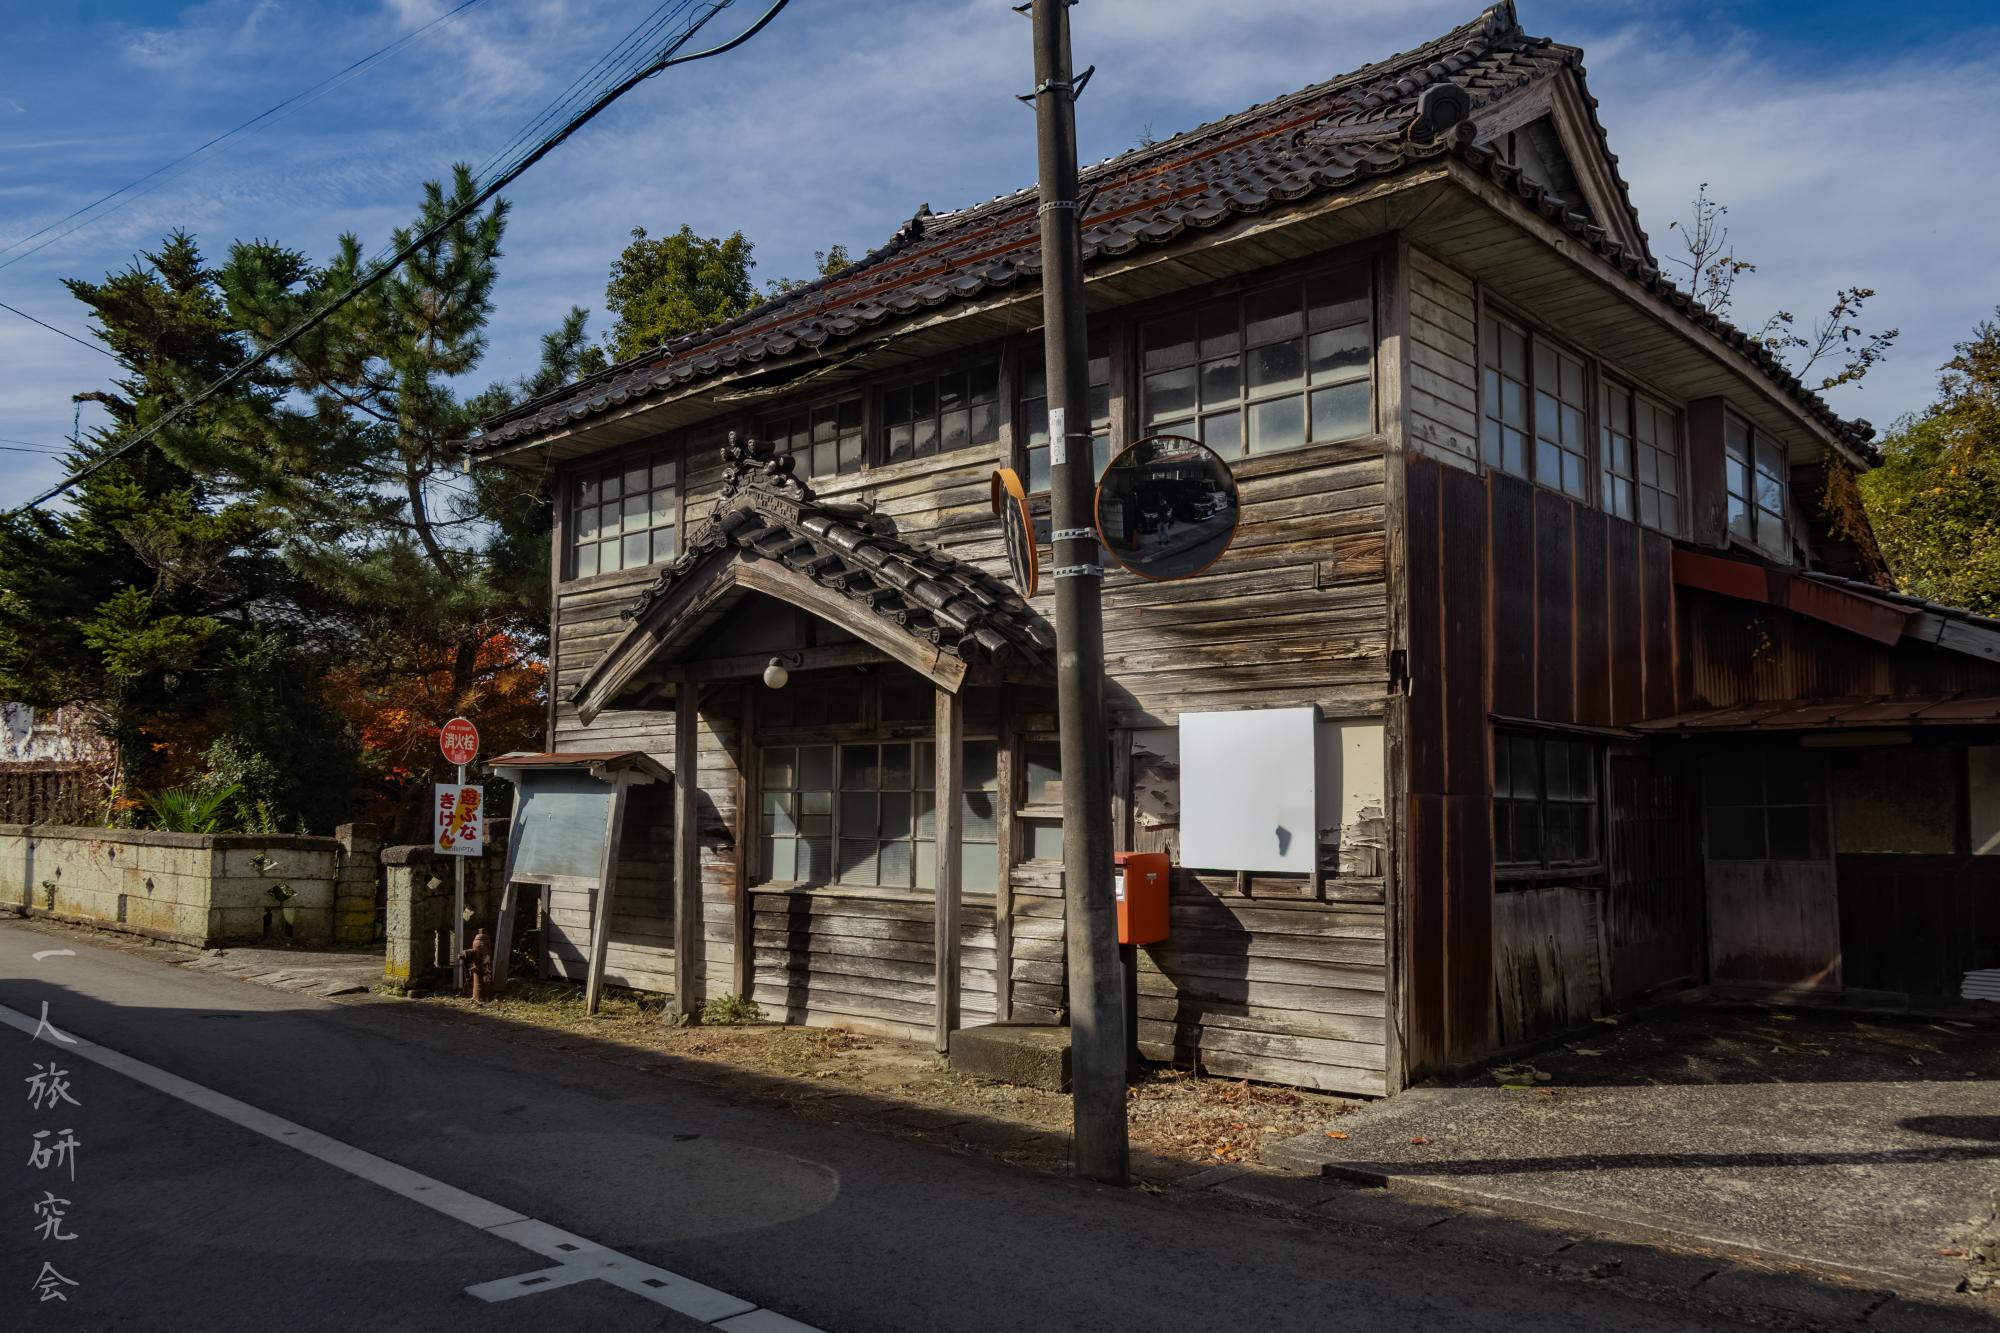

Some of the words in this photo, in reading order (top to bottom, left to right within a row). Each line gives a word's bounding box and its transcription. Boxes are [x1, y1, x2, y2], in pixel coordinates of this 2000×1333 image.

[445, 732, 475, 751] 消火栓
[439, 792, 456, 846] きけん
[460, 788, 478, 840] 遊ぶな
